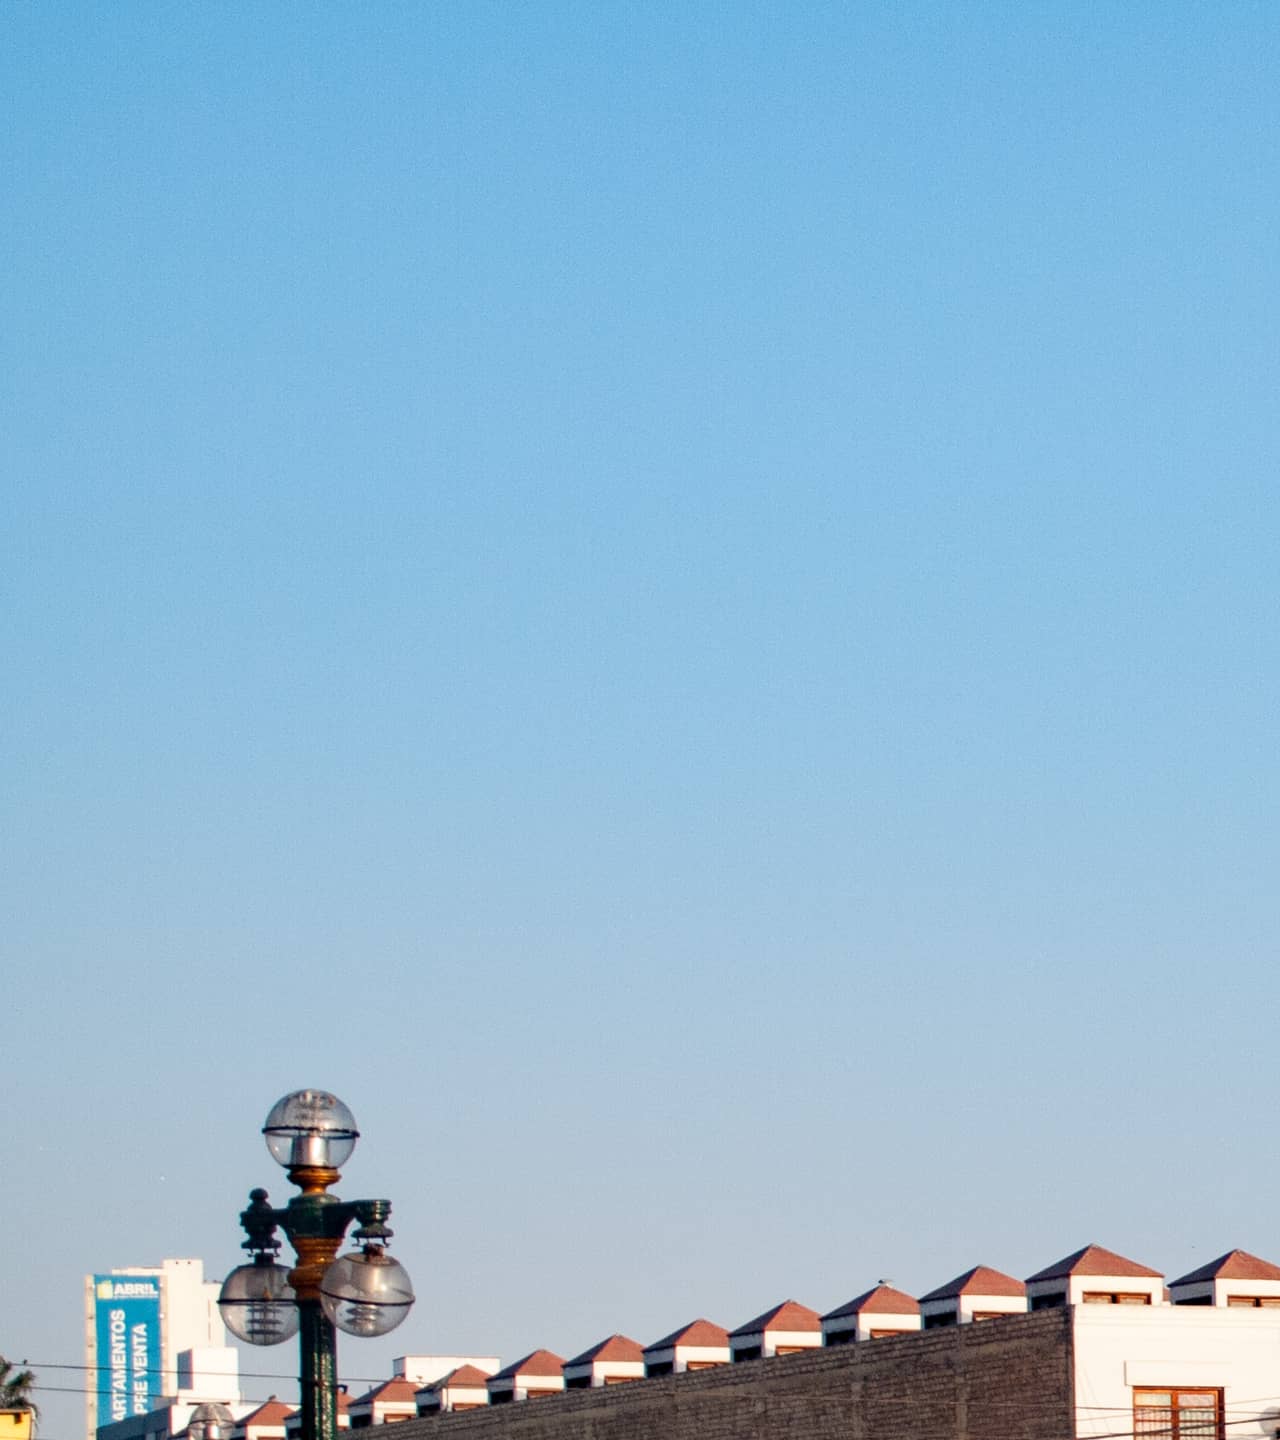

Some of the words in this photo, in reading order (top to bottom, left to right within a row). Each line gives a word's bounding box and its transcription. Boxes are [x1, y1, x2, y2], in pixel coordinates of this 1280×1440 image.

[114, 1284, 158, 1296] ABRIL
[132, 1323, 148, 1378] VENTA
[133, 1380, 149, 1415] PRE
